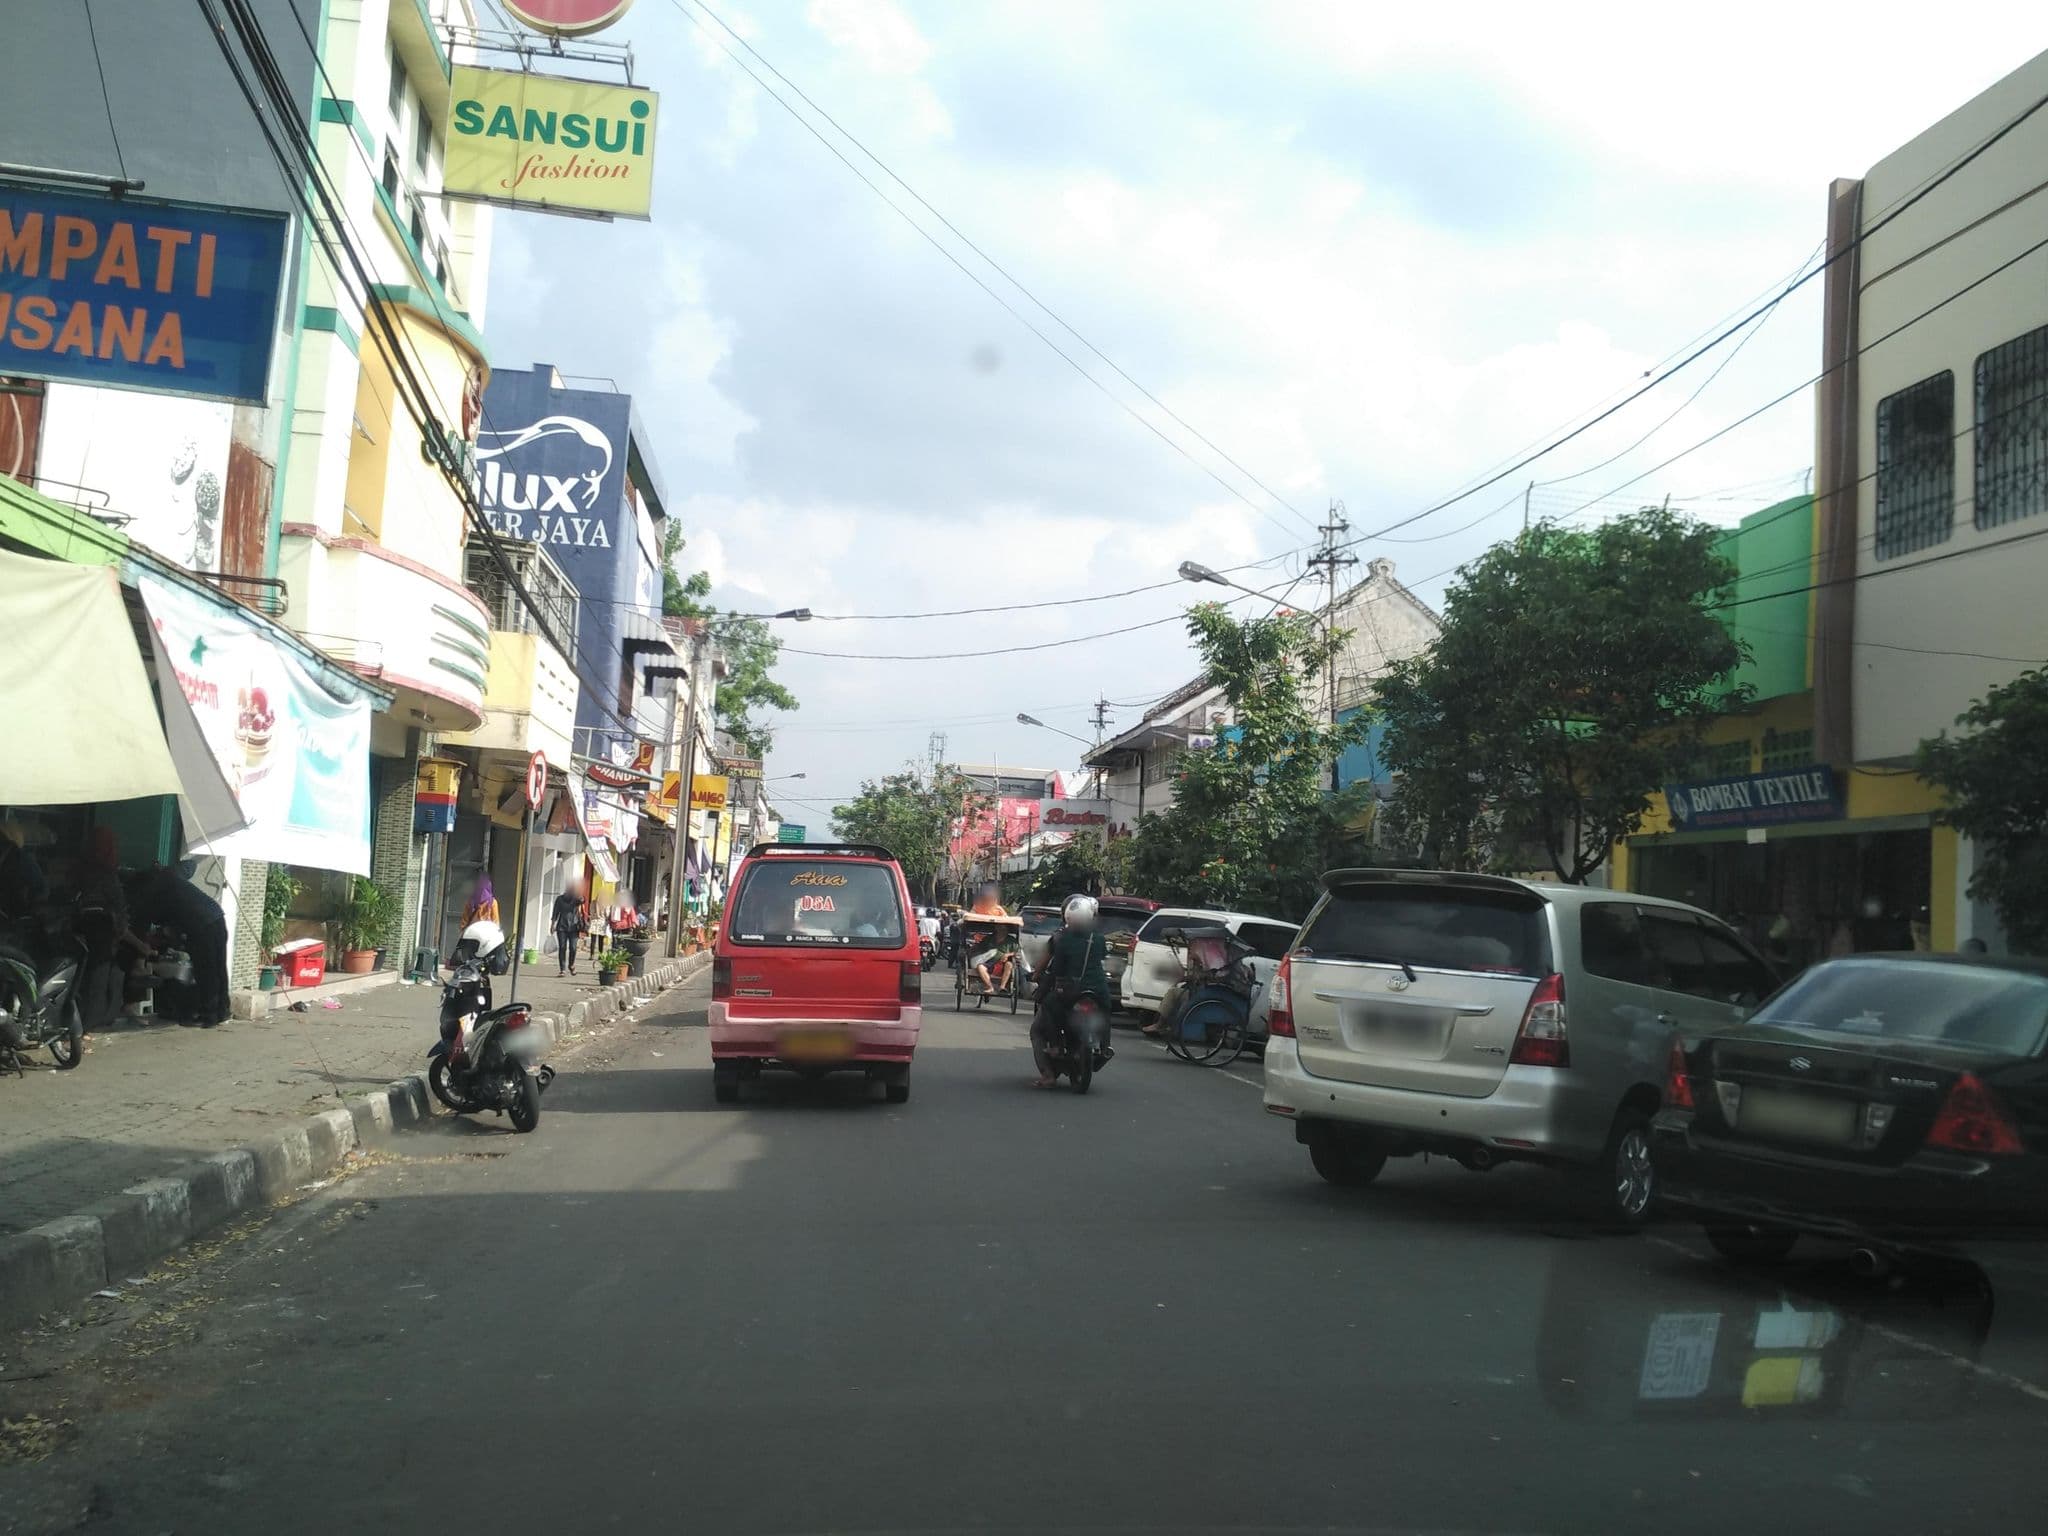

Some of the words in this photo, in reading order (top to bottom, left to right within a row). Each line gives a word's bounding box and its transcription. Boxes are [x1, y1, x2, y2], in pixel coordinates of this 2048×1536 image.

[500, 154, 629, 189] fashion
[475, 460, 580, 514] lux
[532, 516, 611, 548] JAYA
[1689, 781, 1752, 813] BOMBAY
[1754, 772, 1829, 806] TEXTILE
